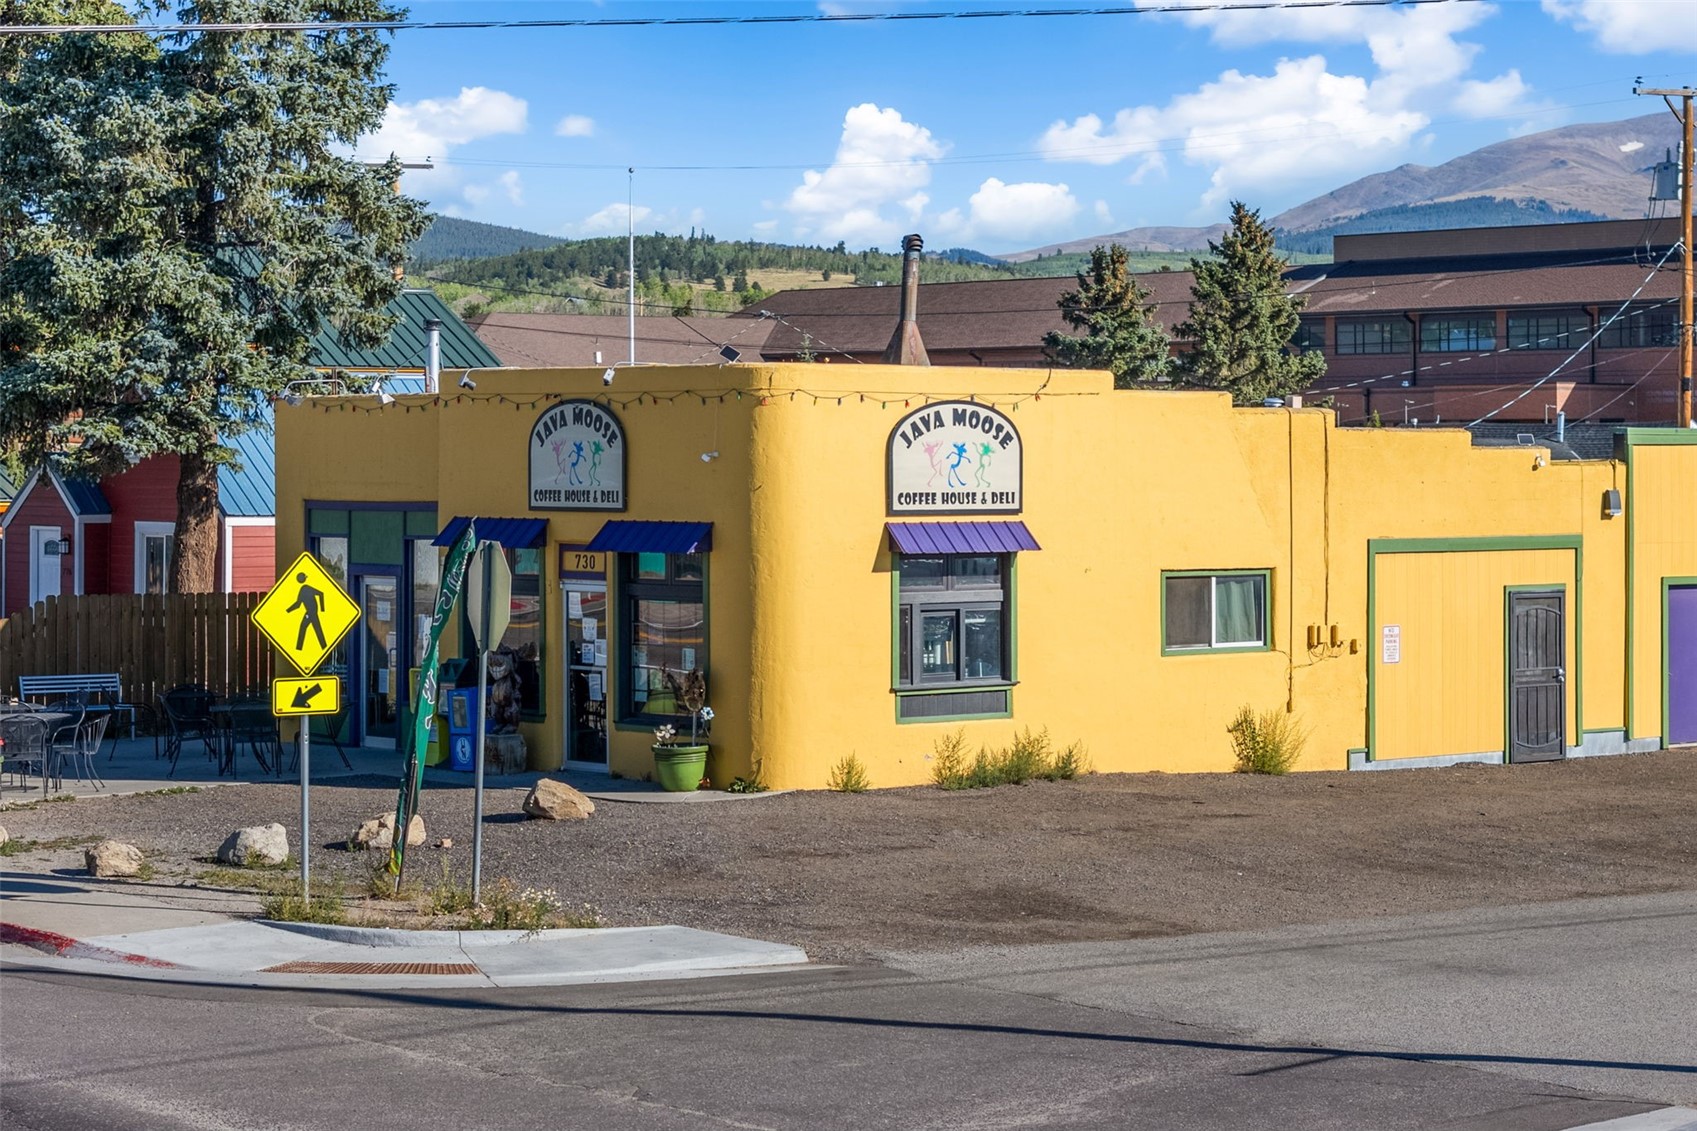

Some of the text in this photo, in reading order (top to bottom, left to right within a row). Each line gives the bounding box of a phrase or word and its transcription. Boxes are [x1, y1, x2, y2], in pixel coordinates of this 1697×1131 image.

[535, 406, 618, 448] JAVA MOOSE
[899, 408, 1014, 450] JAVA MOOSE
[534, 489, 619, 503] COFFEE HOUSE & DELI
[897, 492, 1016, 505] COFFEE HOUSE & DELI
[575, 554, 596, 570] 730
